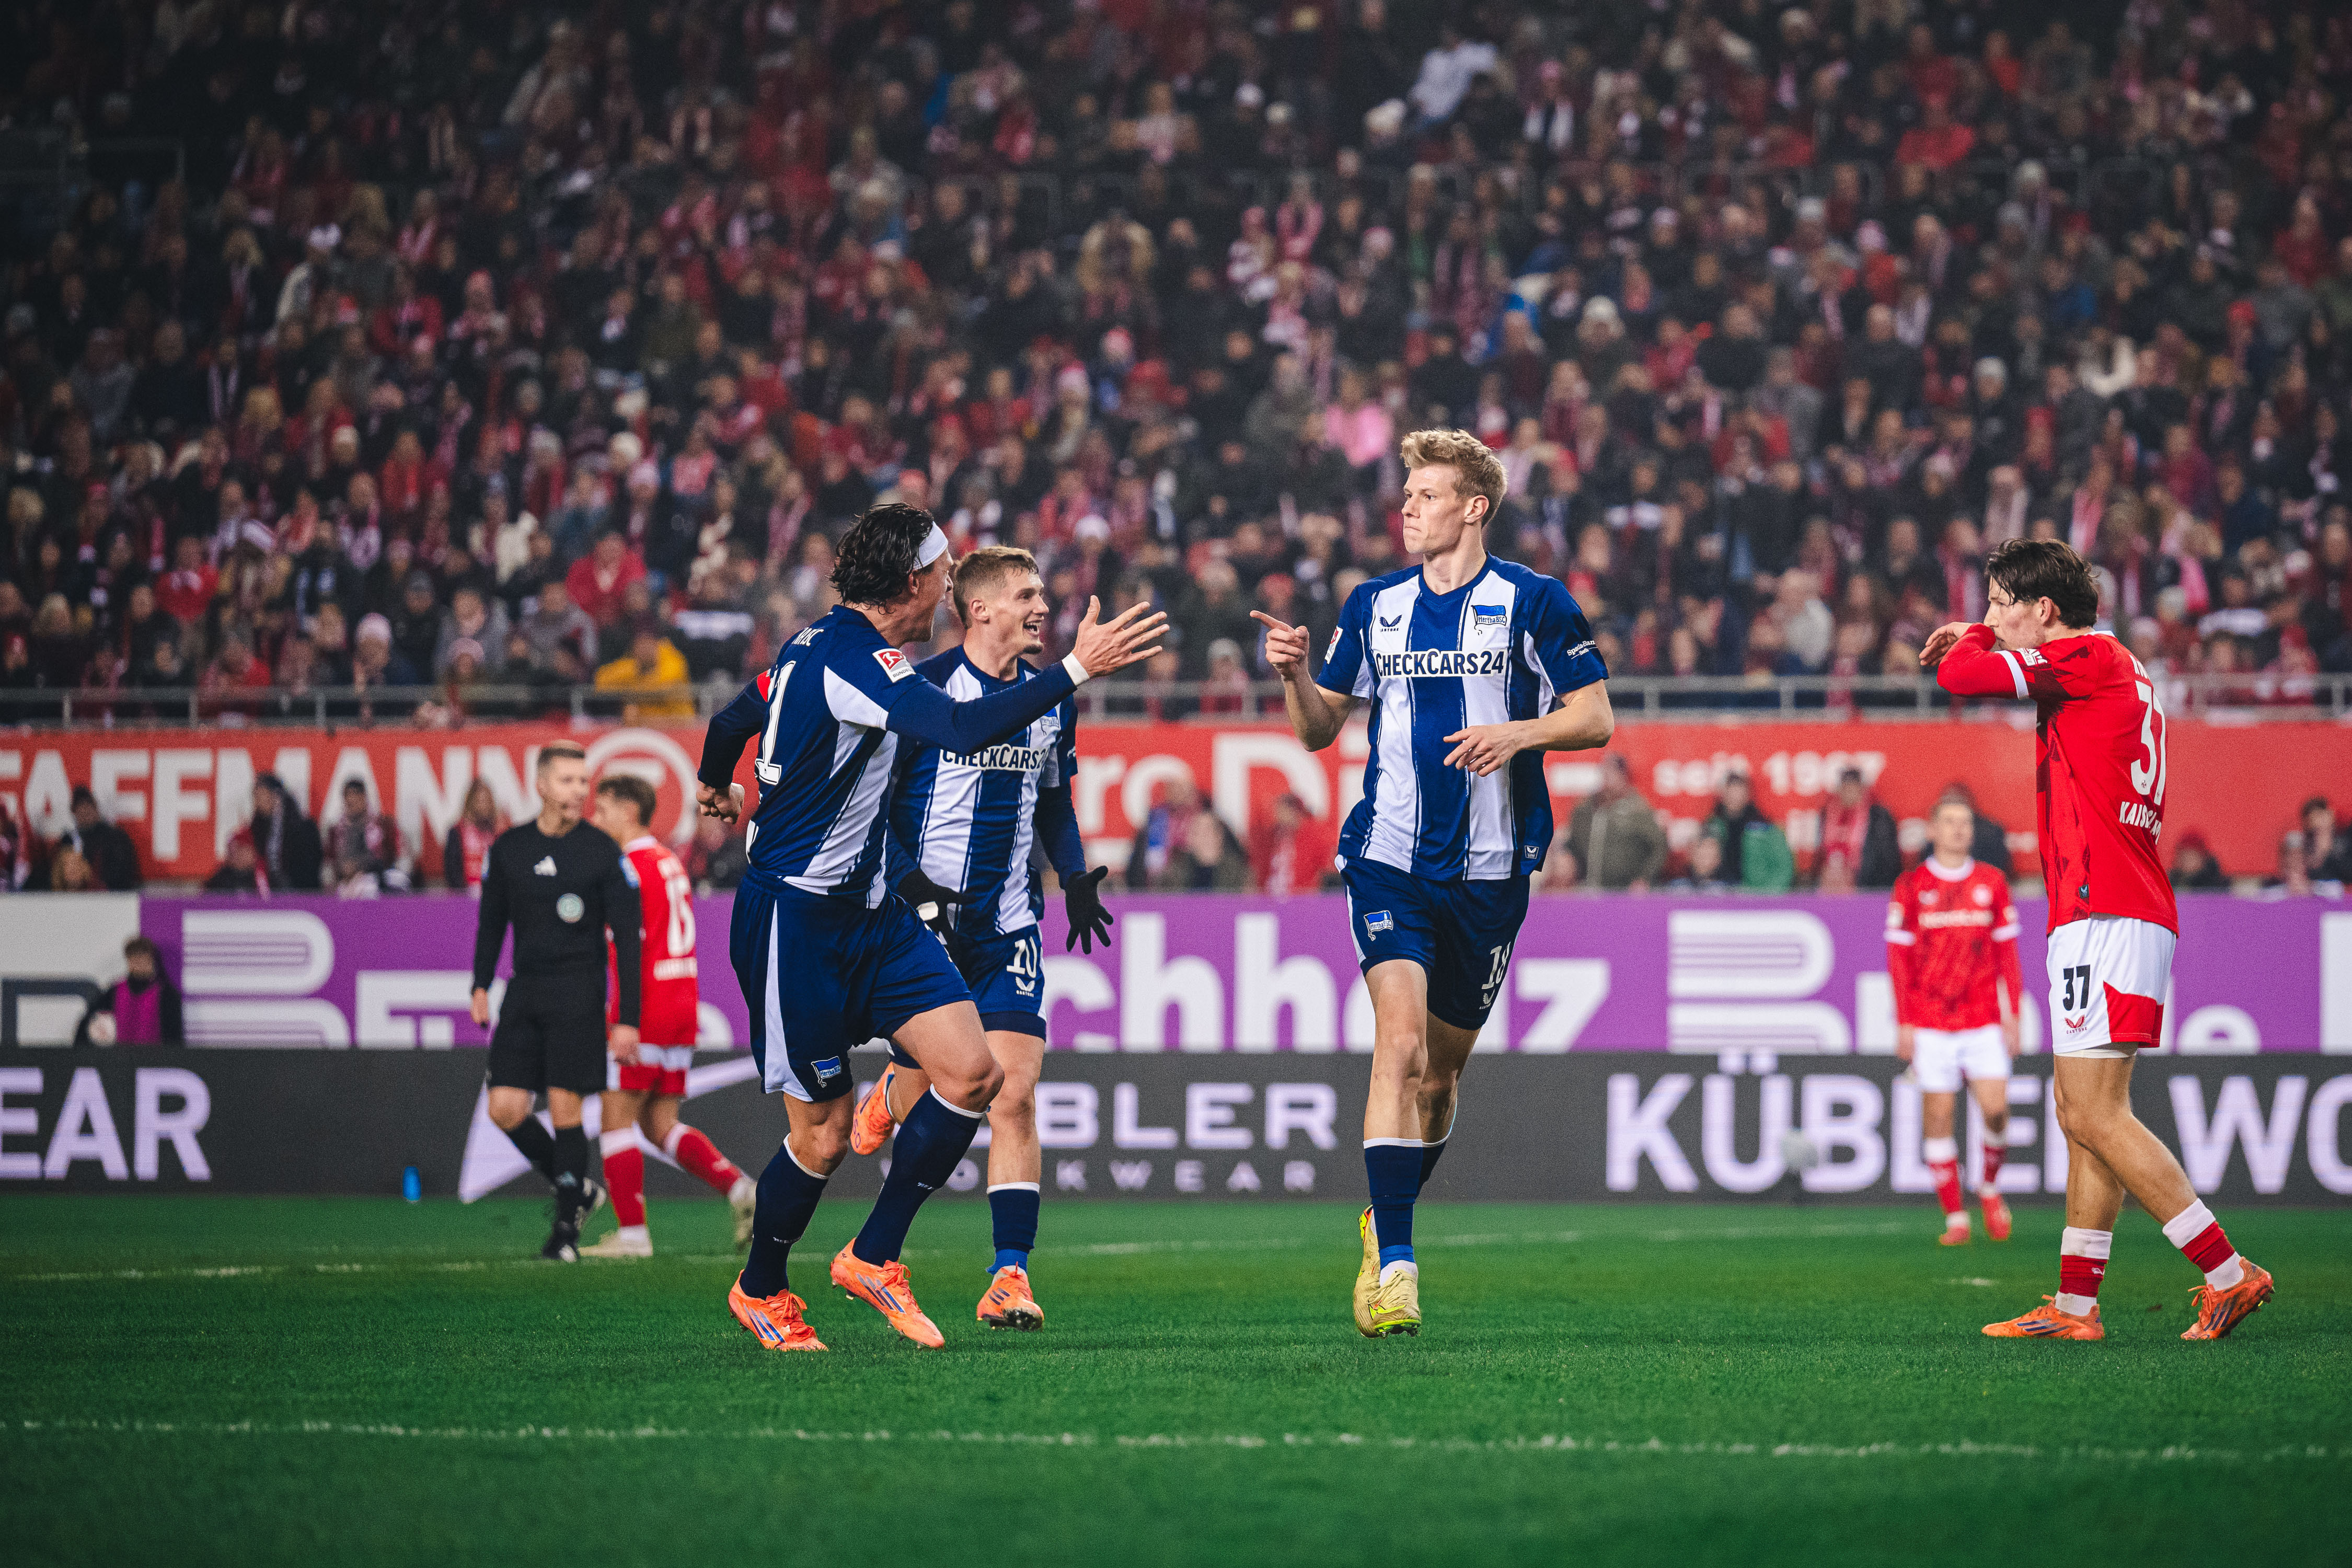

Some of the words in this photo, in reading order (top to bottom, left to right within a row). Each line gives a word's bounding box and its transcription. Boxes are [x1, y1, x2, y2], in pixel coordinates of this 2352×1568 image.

[1376, 651, 1504, 676] CHECKCARS24
[1007, 936, 1037, 978] 10
[1482, 941, 1511, 989] 18
[2062, 964, 2090, 1011] 37
[857, 1081, 1337, 1149] BLER
[880, 1157, 1316, 1193] OKWEAR
